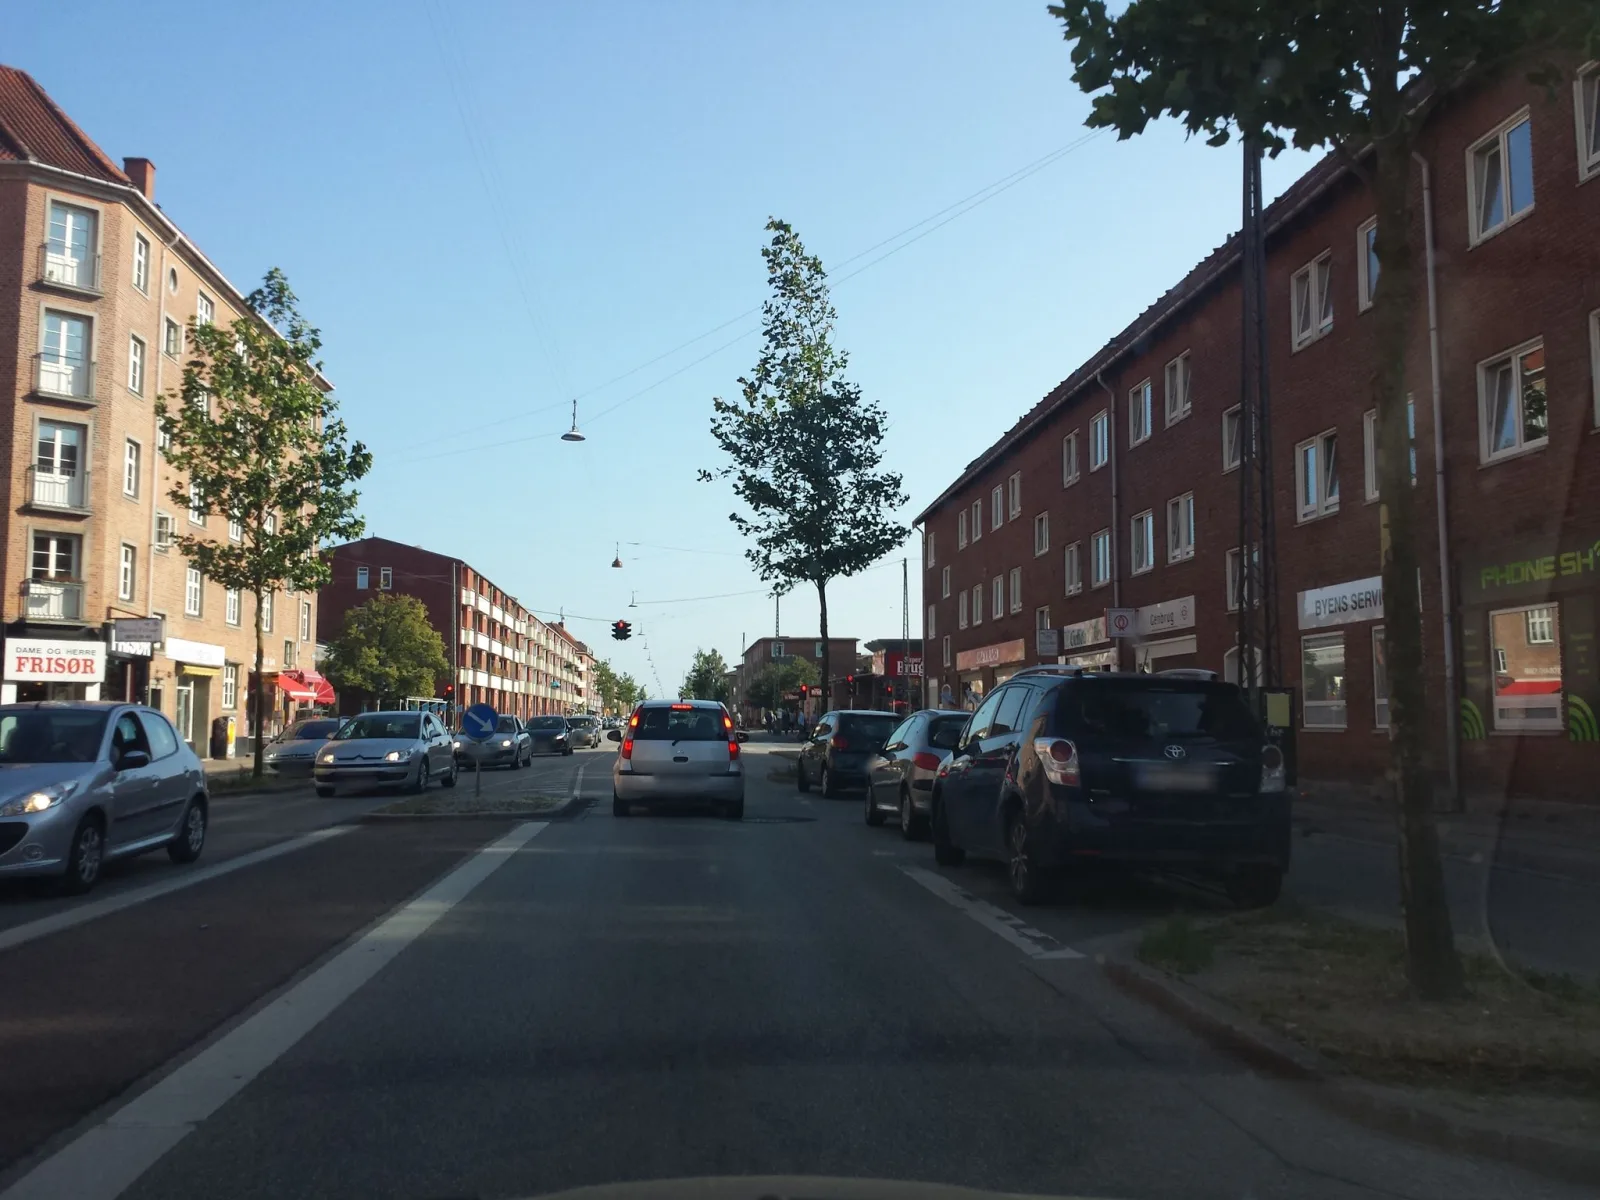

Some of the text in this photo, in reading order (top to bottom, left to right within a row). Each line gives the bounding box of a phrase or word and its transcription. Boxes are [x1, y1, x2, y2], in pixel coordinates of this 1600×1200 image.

[1481, 555, 1556, 590] PHONE
[1315, 588, 1383, 616] BYENS SERVI
[16, 646, 96, 657] DAME OG HERRE
[15, 656, 96, 674] FRISØR
[896, 660, 924, 677] Brug
